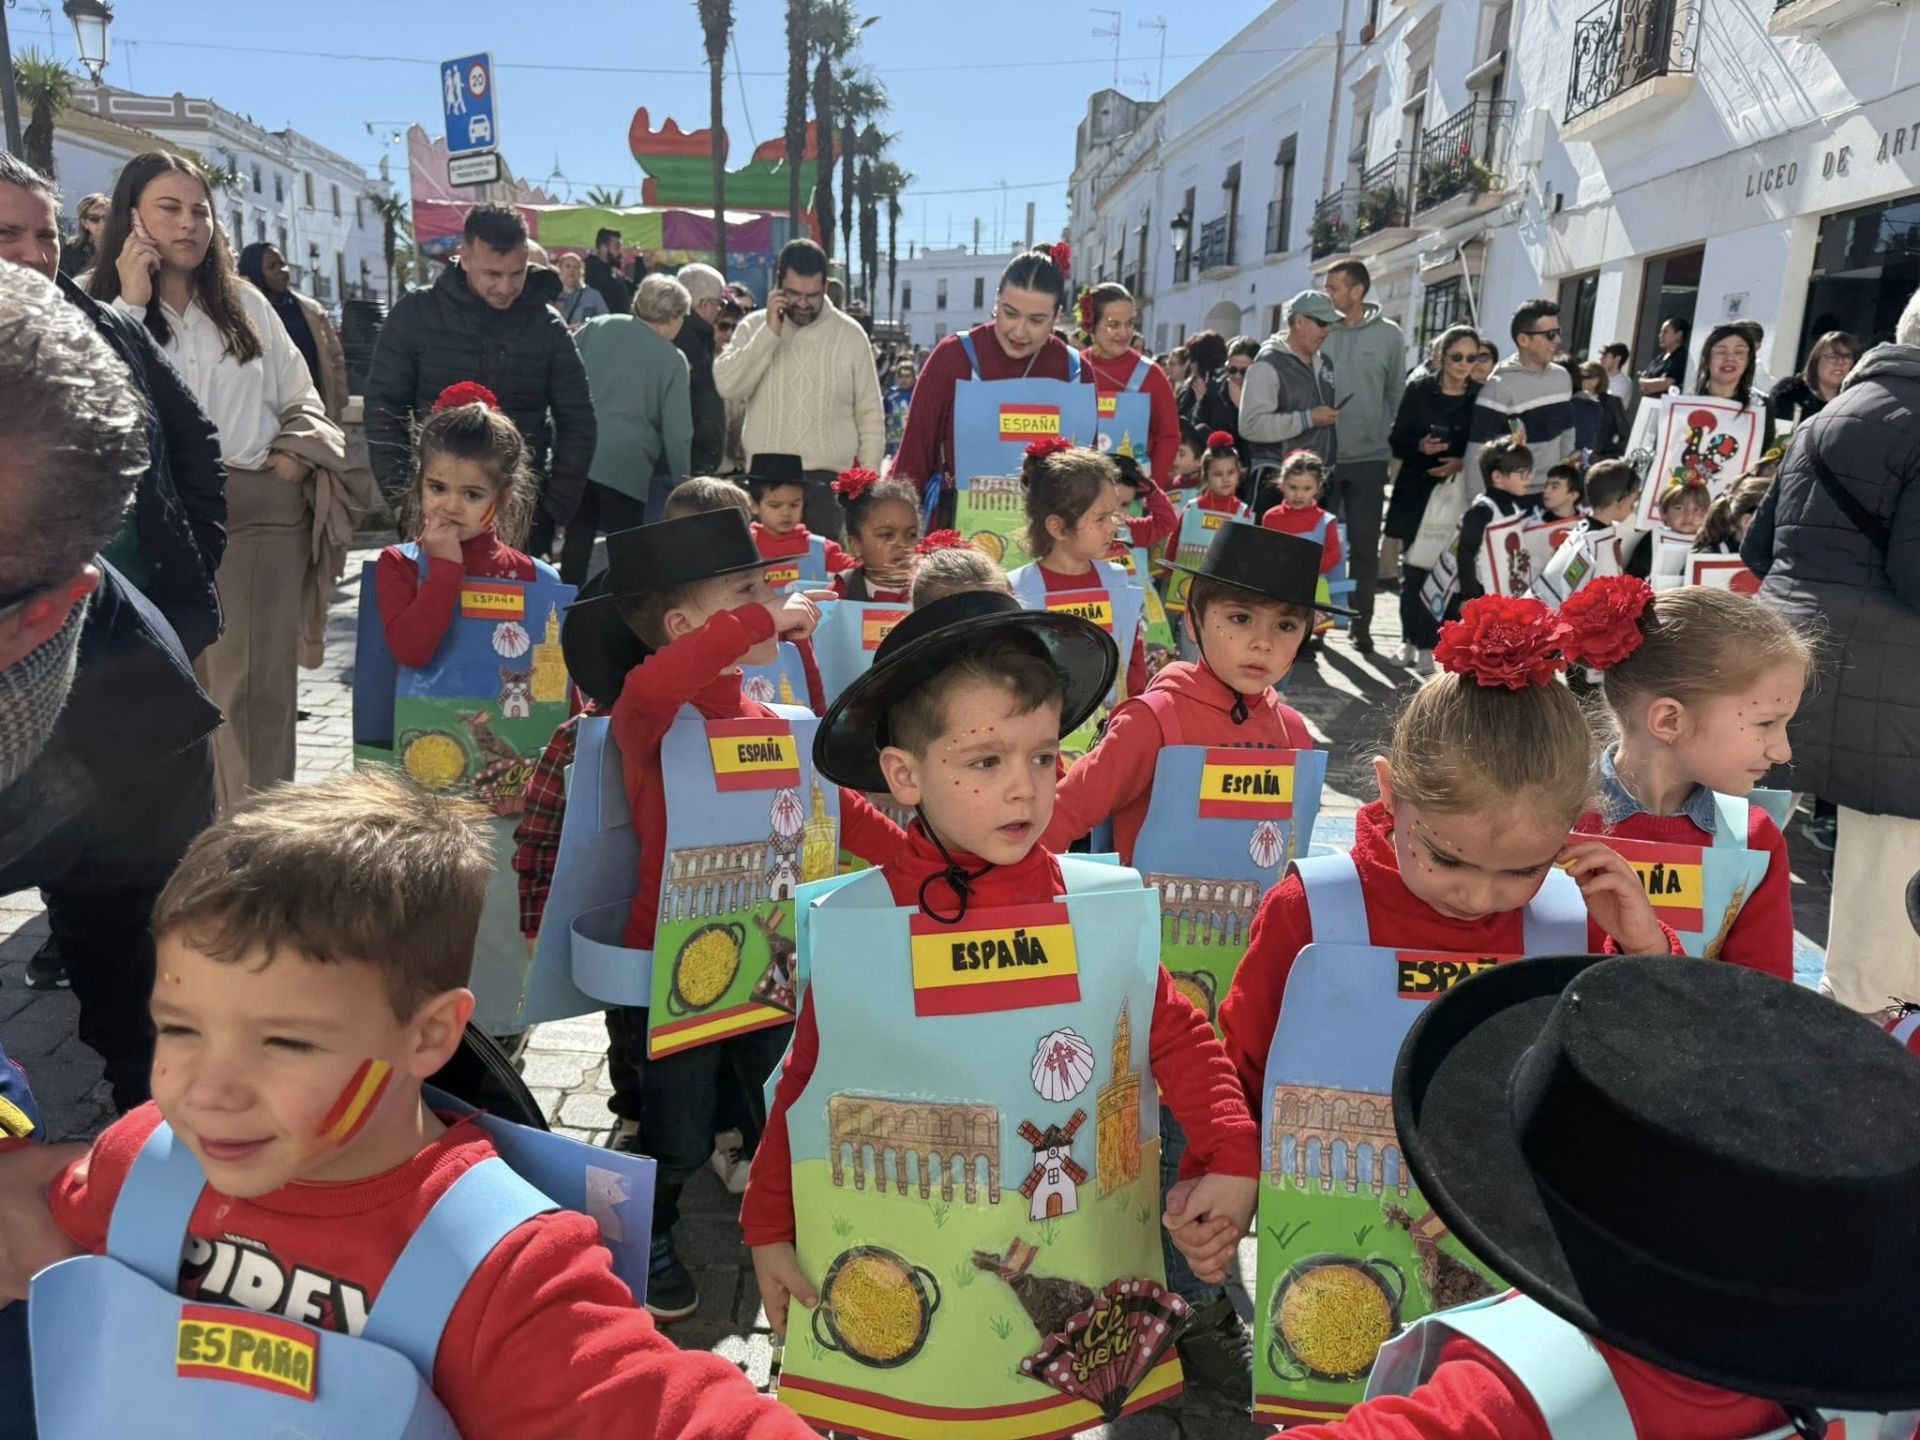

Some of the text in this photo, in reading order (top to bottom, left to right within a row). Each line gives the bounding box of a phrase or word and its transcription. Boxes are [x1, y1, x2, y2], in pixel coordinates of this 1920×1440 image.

[472, 73, 484, 87] 20
[1746, 162, 1798, 198] LICEO
[1822, 145, 1850, 177] DE
[1002, 415, 1058, 432] ESPAÑA
[472, 594, 516, 604] ESPAÑA
[737, 737, 784, 764] ESPAÑA
[1221, 769, 1280, 796] ESPAÑA
[951, 929, 1049, 972] ESPAÑA
[178, 1323, 311, 1388] ESPAÑA
